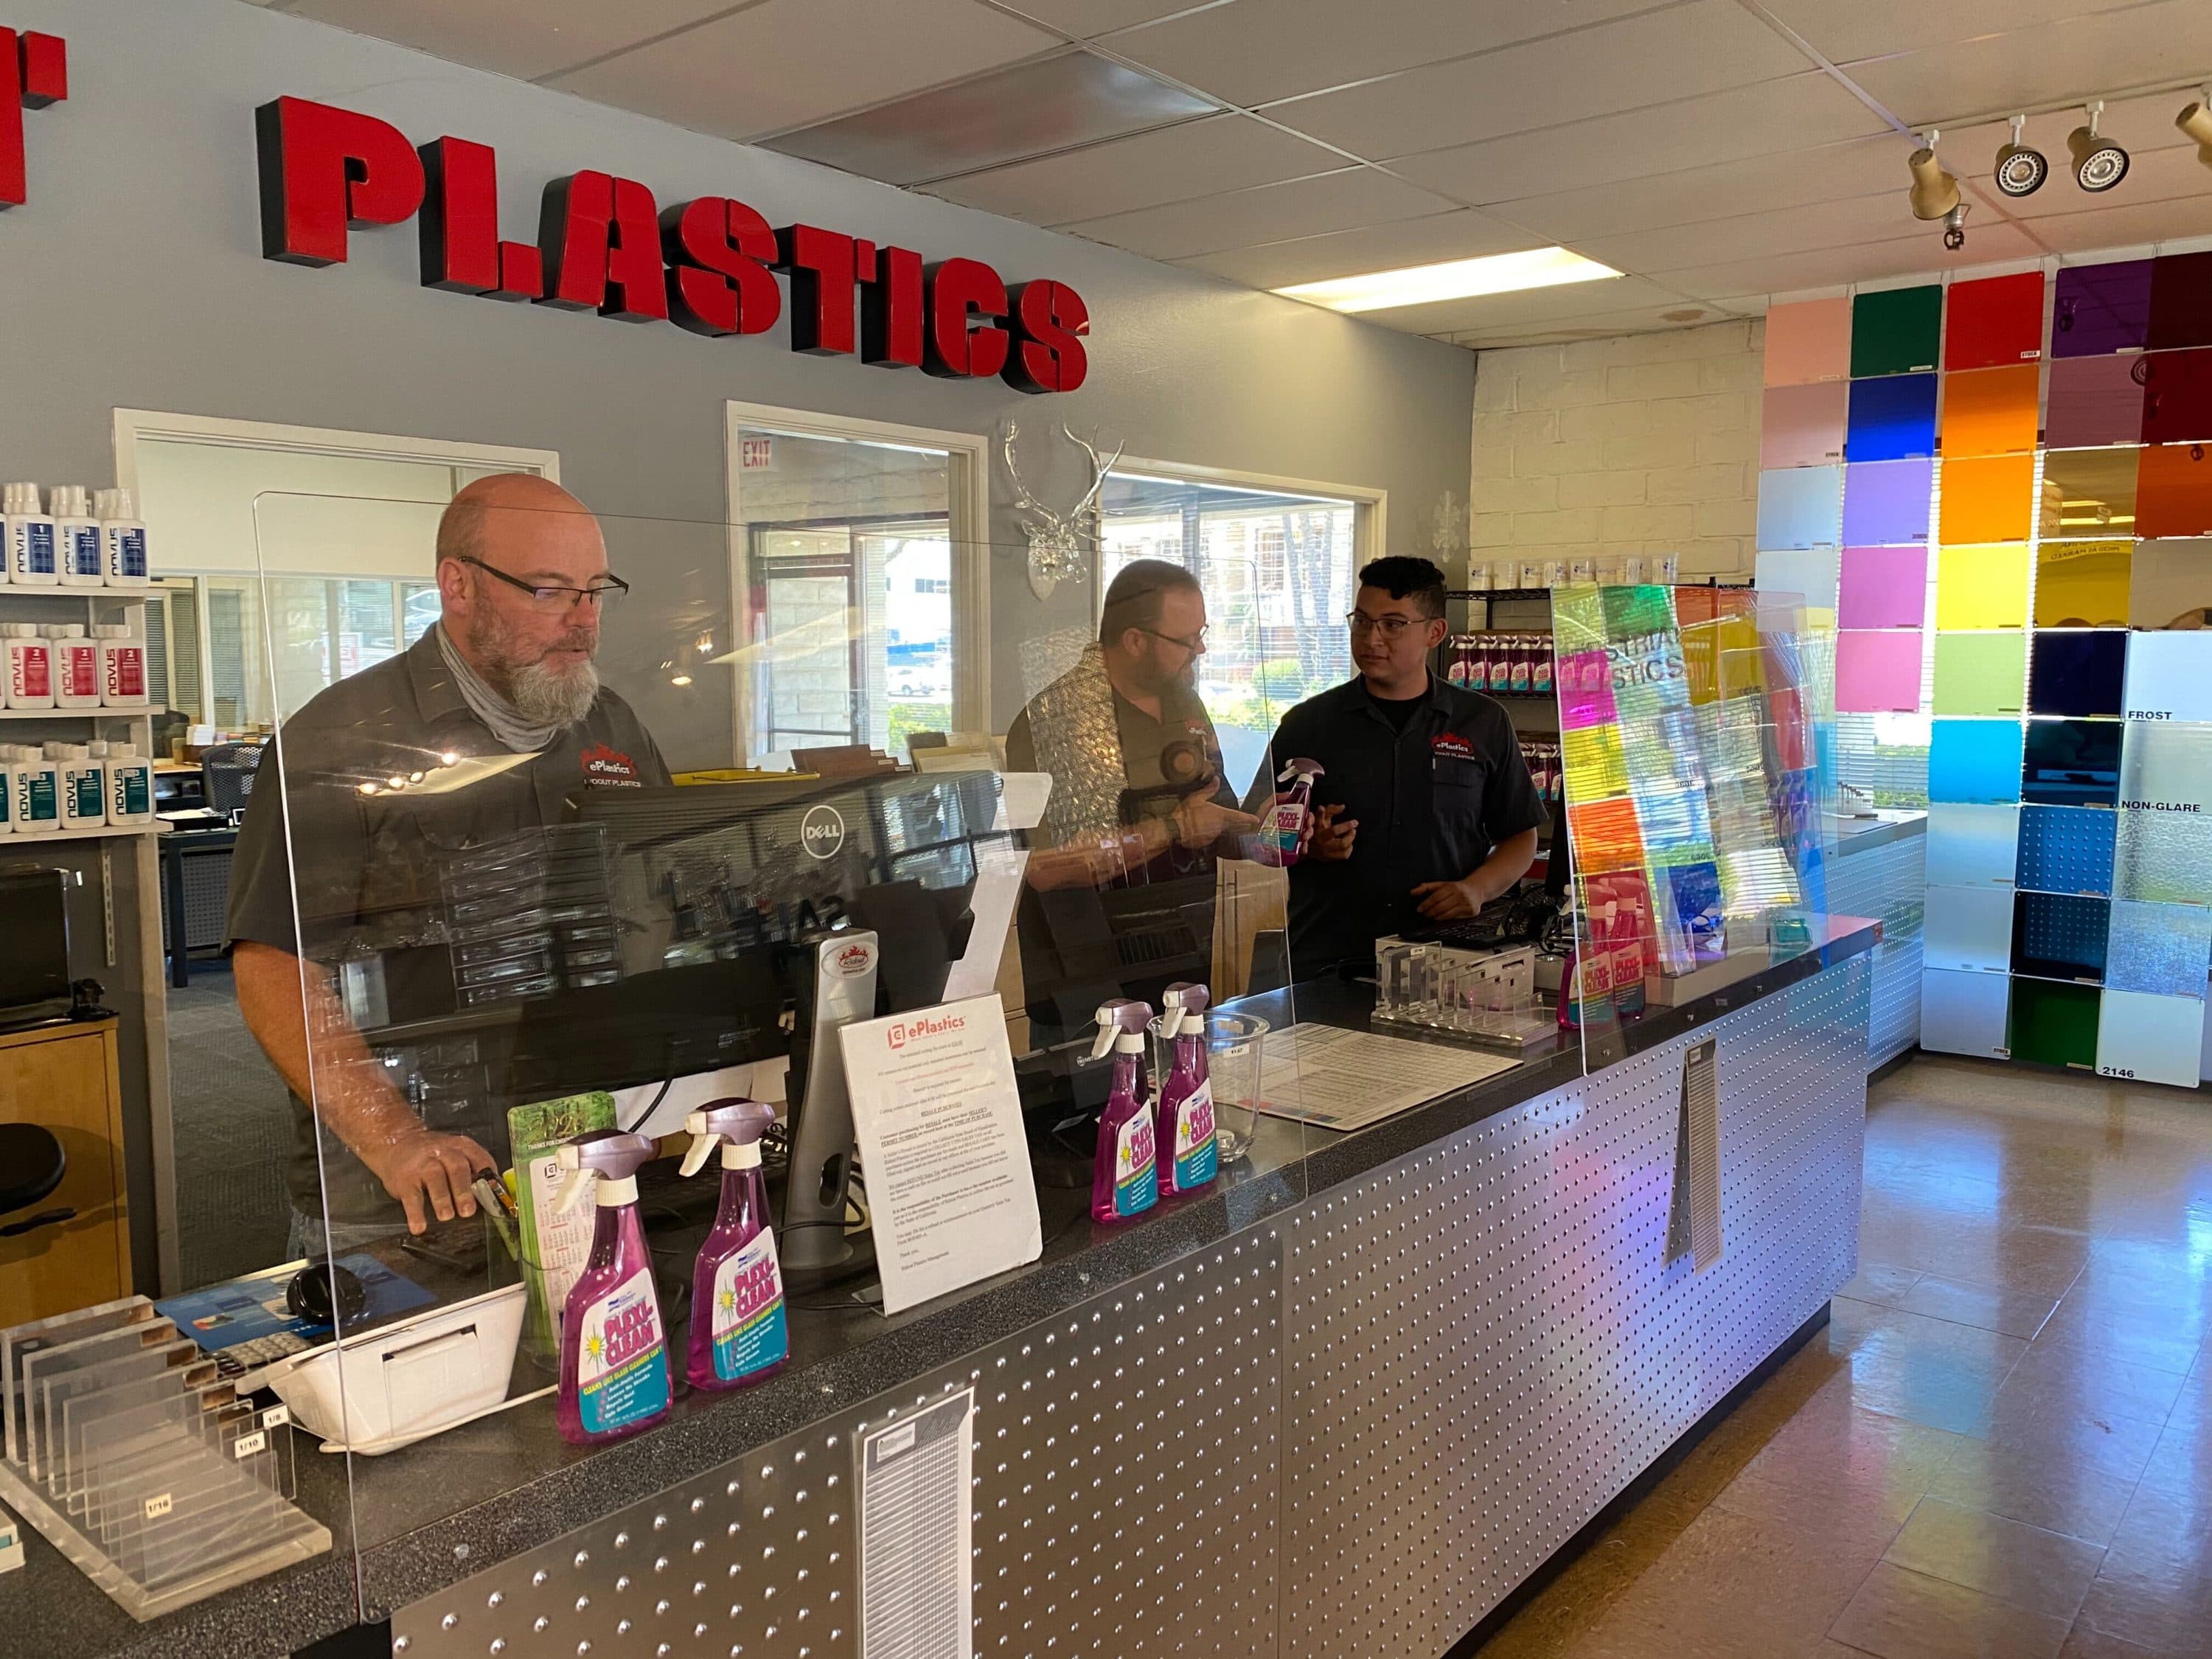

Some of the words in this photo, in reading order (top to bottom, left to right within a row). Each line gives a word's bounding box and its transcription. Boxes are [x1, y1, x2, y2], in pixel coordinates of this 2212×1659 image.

[255, 95, 1089, 395] PLASTICS
[742, 439, 771, 467] EXIT
[32, 649, 40, 657] 2
[81, 649, 88, 657] 2
[2128, 711, 2172, 720] FROST
[1436, 742, 1468, 751] ePlastics
[589, 759, 630, 774] ePlastics
[18, 773, 30, 821] NOVUS
[66, 771, 77, 818] NOVUS
[114, 768, 125, 815] NOVUS
[2121, 800, 2201, 813] NON-GLARE
[807, 824, 840, 839] DELL
[908, 1015, 965, 1038] ePlastics
[2102, 1066, 2135, 1078] 2146
[1190, 1113, 1214, 1145] CLEAN
[527, 1142, 546, 1150] THANKS
[1131, 1136, 1154, 1169] CLEAN
[734, 1255, 775, 1298] PLEXI-
[736, 1275, 776, 1318] CLEAN
[605, 1300, 653, 1345] PLEXI-
[605, 1321, 655, 1366] CLEAN
[268, 1413, 282, 1423] 1/8
[239, 1439, 259, 1452] 1/10
[147, 1501, 170, 1513] 1/16
